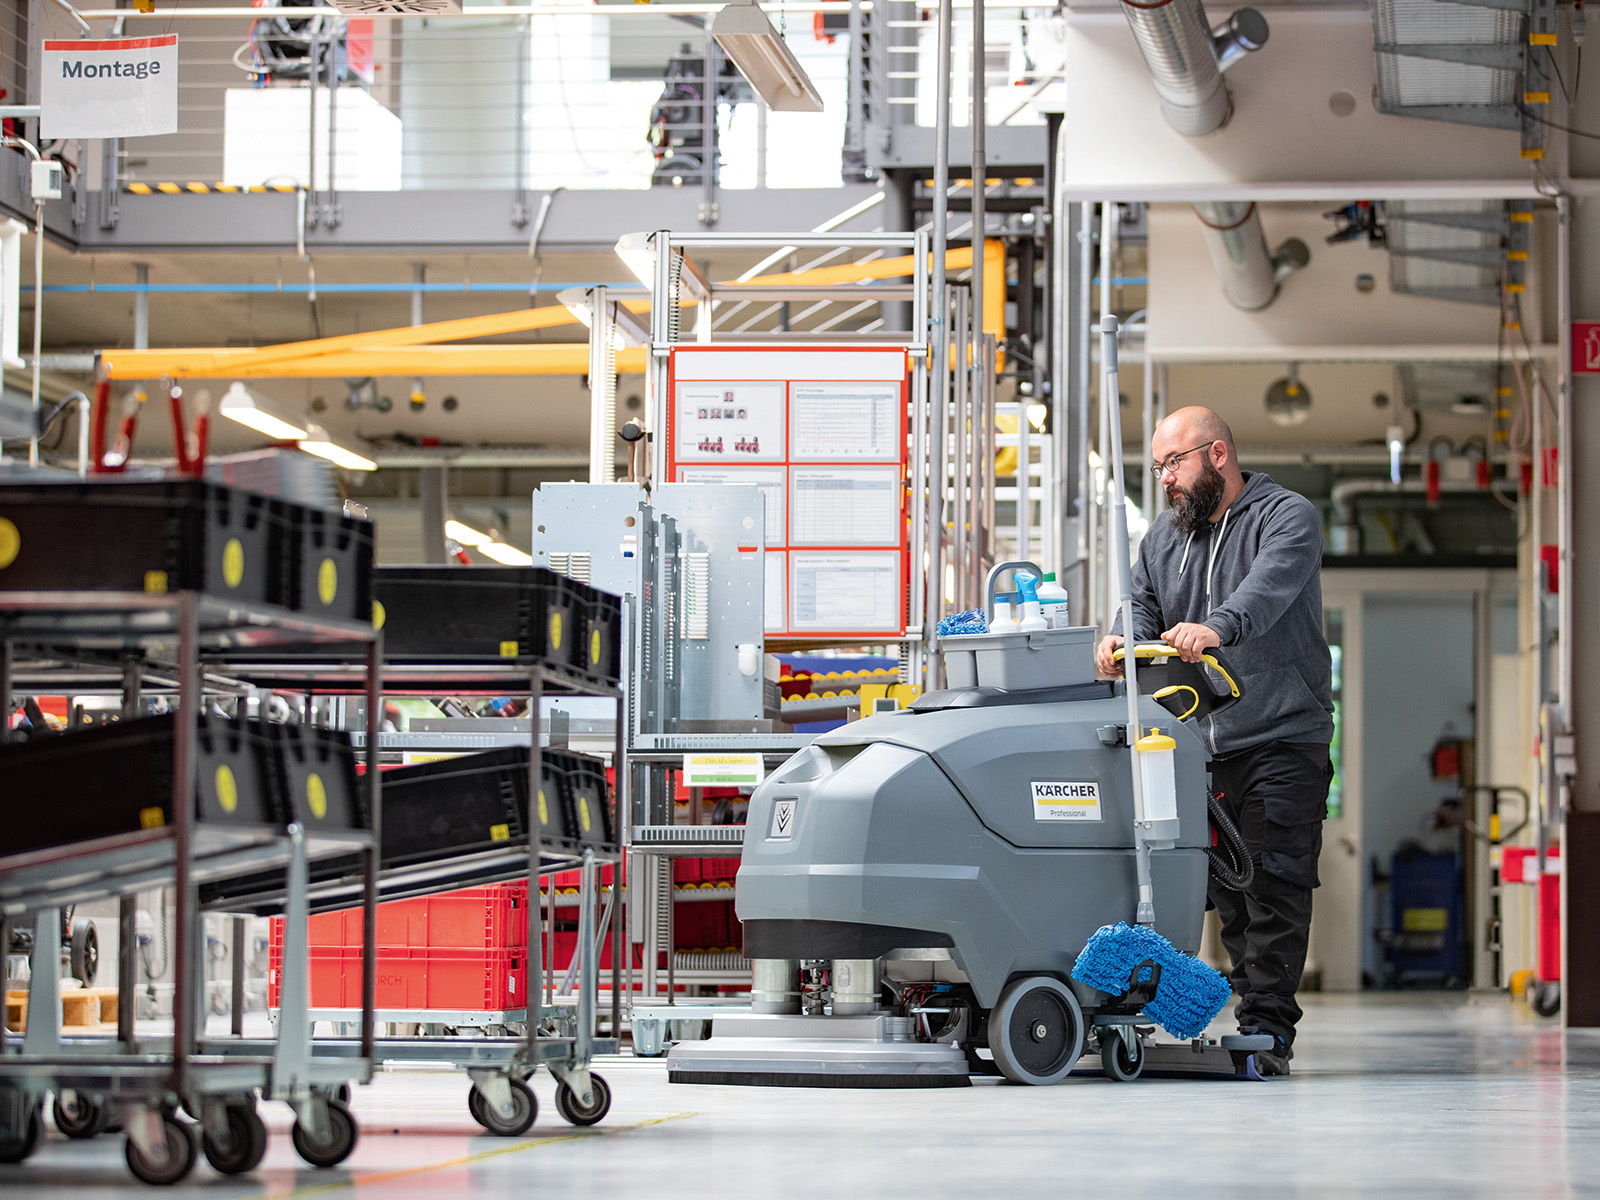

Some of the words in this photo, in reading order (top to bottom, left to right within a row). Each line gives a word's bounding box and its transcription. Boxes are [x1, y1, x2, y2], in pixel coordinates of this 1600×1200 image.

[62, 60, 161, 80] Montage
[1035, 784, 1096, 797] KÄRCHER
[1050, 809, 1087, 817] Professional
